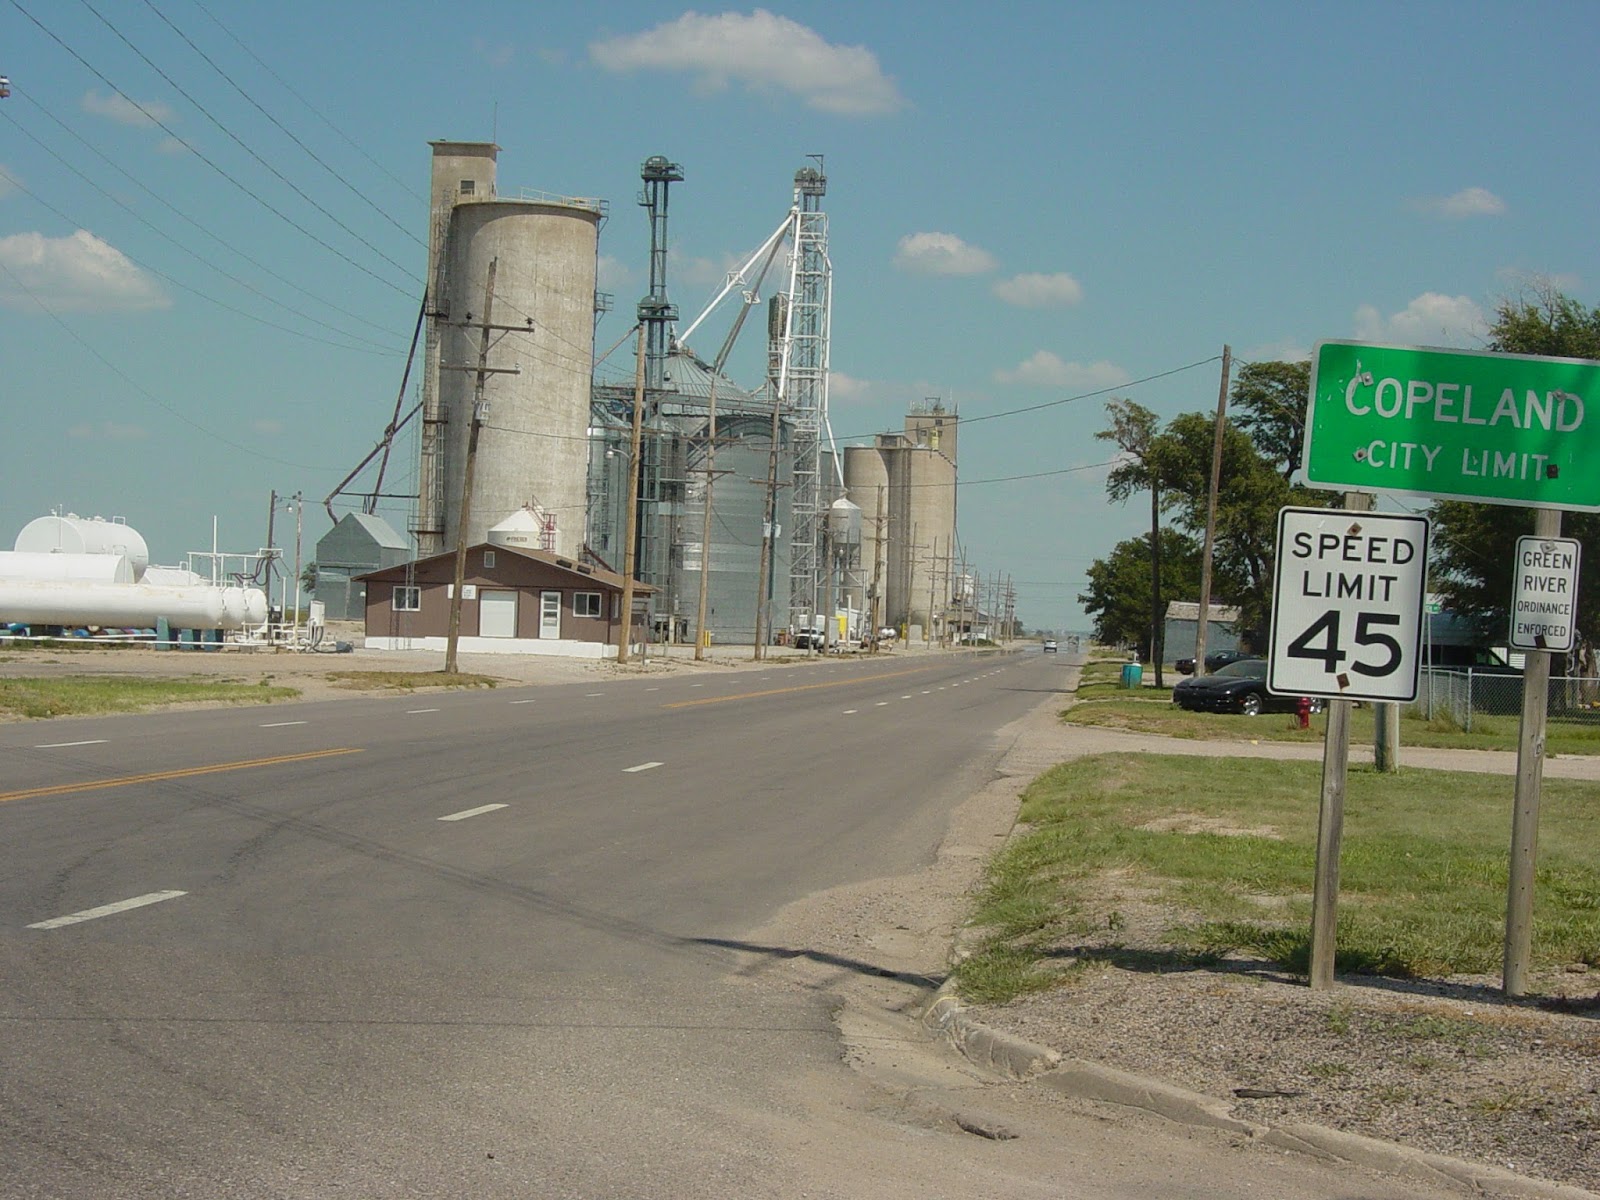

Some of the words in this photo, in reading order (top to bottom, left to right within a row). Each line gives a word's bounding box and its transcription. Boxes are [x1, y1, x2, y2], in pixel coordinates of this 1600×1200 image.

[1345, 375, 1585, 432] COPELAND
[1366, 440, 1443, 472] CITY
[1461, 448, 1549, 481] LIMIT
[1291, 532, 1414, 565] SPEED
[1523, 551, 1572, 570] GREEN
[1302, 571, 1398, 602] LIMIT
[1524, 575, 1567, 593] RIVER
[1517, 600, 1570, 615] ORDINANCE
[1287, 610, 1402, 677] 45
[1517, 623, 1566, 637] ENFORCED
